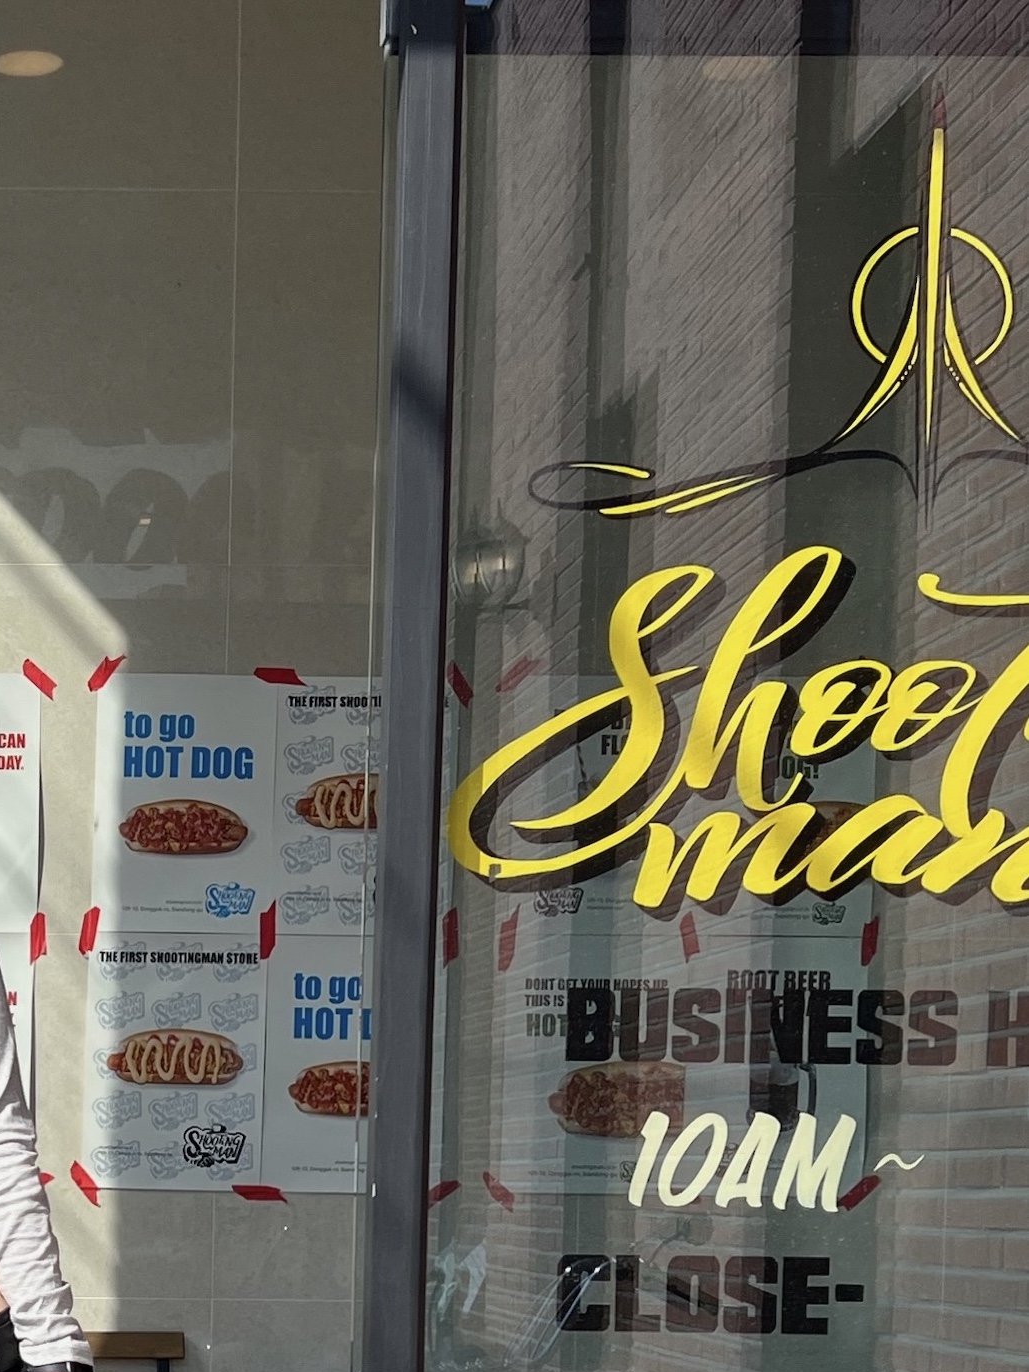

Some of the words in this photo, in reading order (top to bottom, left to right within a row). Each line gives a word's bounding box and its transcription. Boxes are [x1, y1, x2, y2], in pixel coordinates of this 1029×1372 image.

[288, 695, 307, 708] THE
[309, 695, 338, 708] FIRST
[123, 710, 152, 739] to
[160, 713, 195, 742] go
[123, 746, 184, 779] HOT
[190, 746, 254, 780] DOG
[99, 951, 118, 963] THE
[120, 951, 148, 963] FIRST
[150, 951, 224, 965] SHOOTINGMAN
[226, 952, 259, 965] STORE
[294, 972, 322, 1000] to
[525, 977, 556, 991] DONT
[558, 978, 580, 990] GET
[614, 978, 650, 991] HOPES
[727, 969, 779, 990] ROOT
[784, 970, 831, 991] BEER
[524, 995, 551, 1007] THIS
[553, 995, 565, 1007] IS
[293, 1008, 354, 1040] HOT
[565, 988, 958, 1065] BUSINESS
